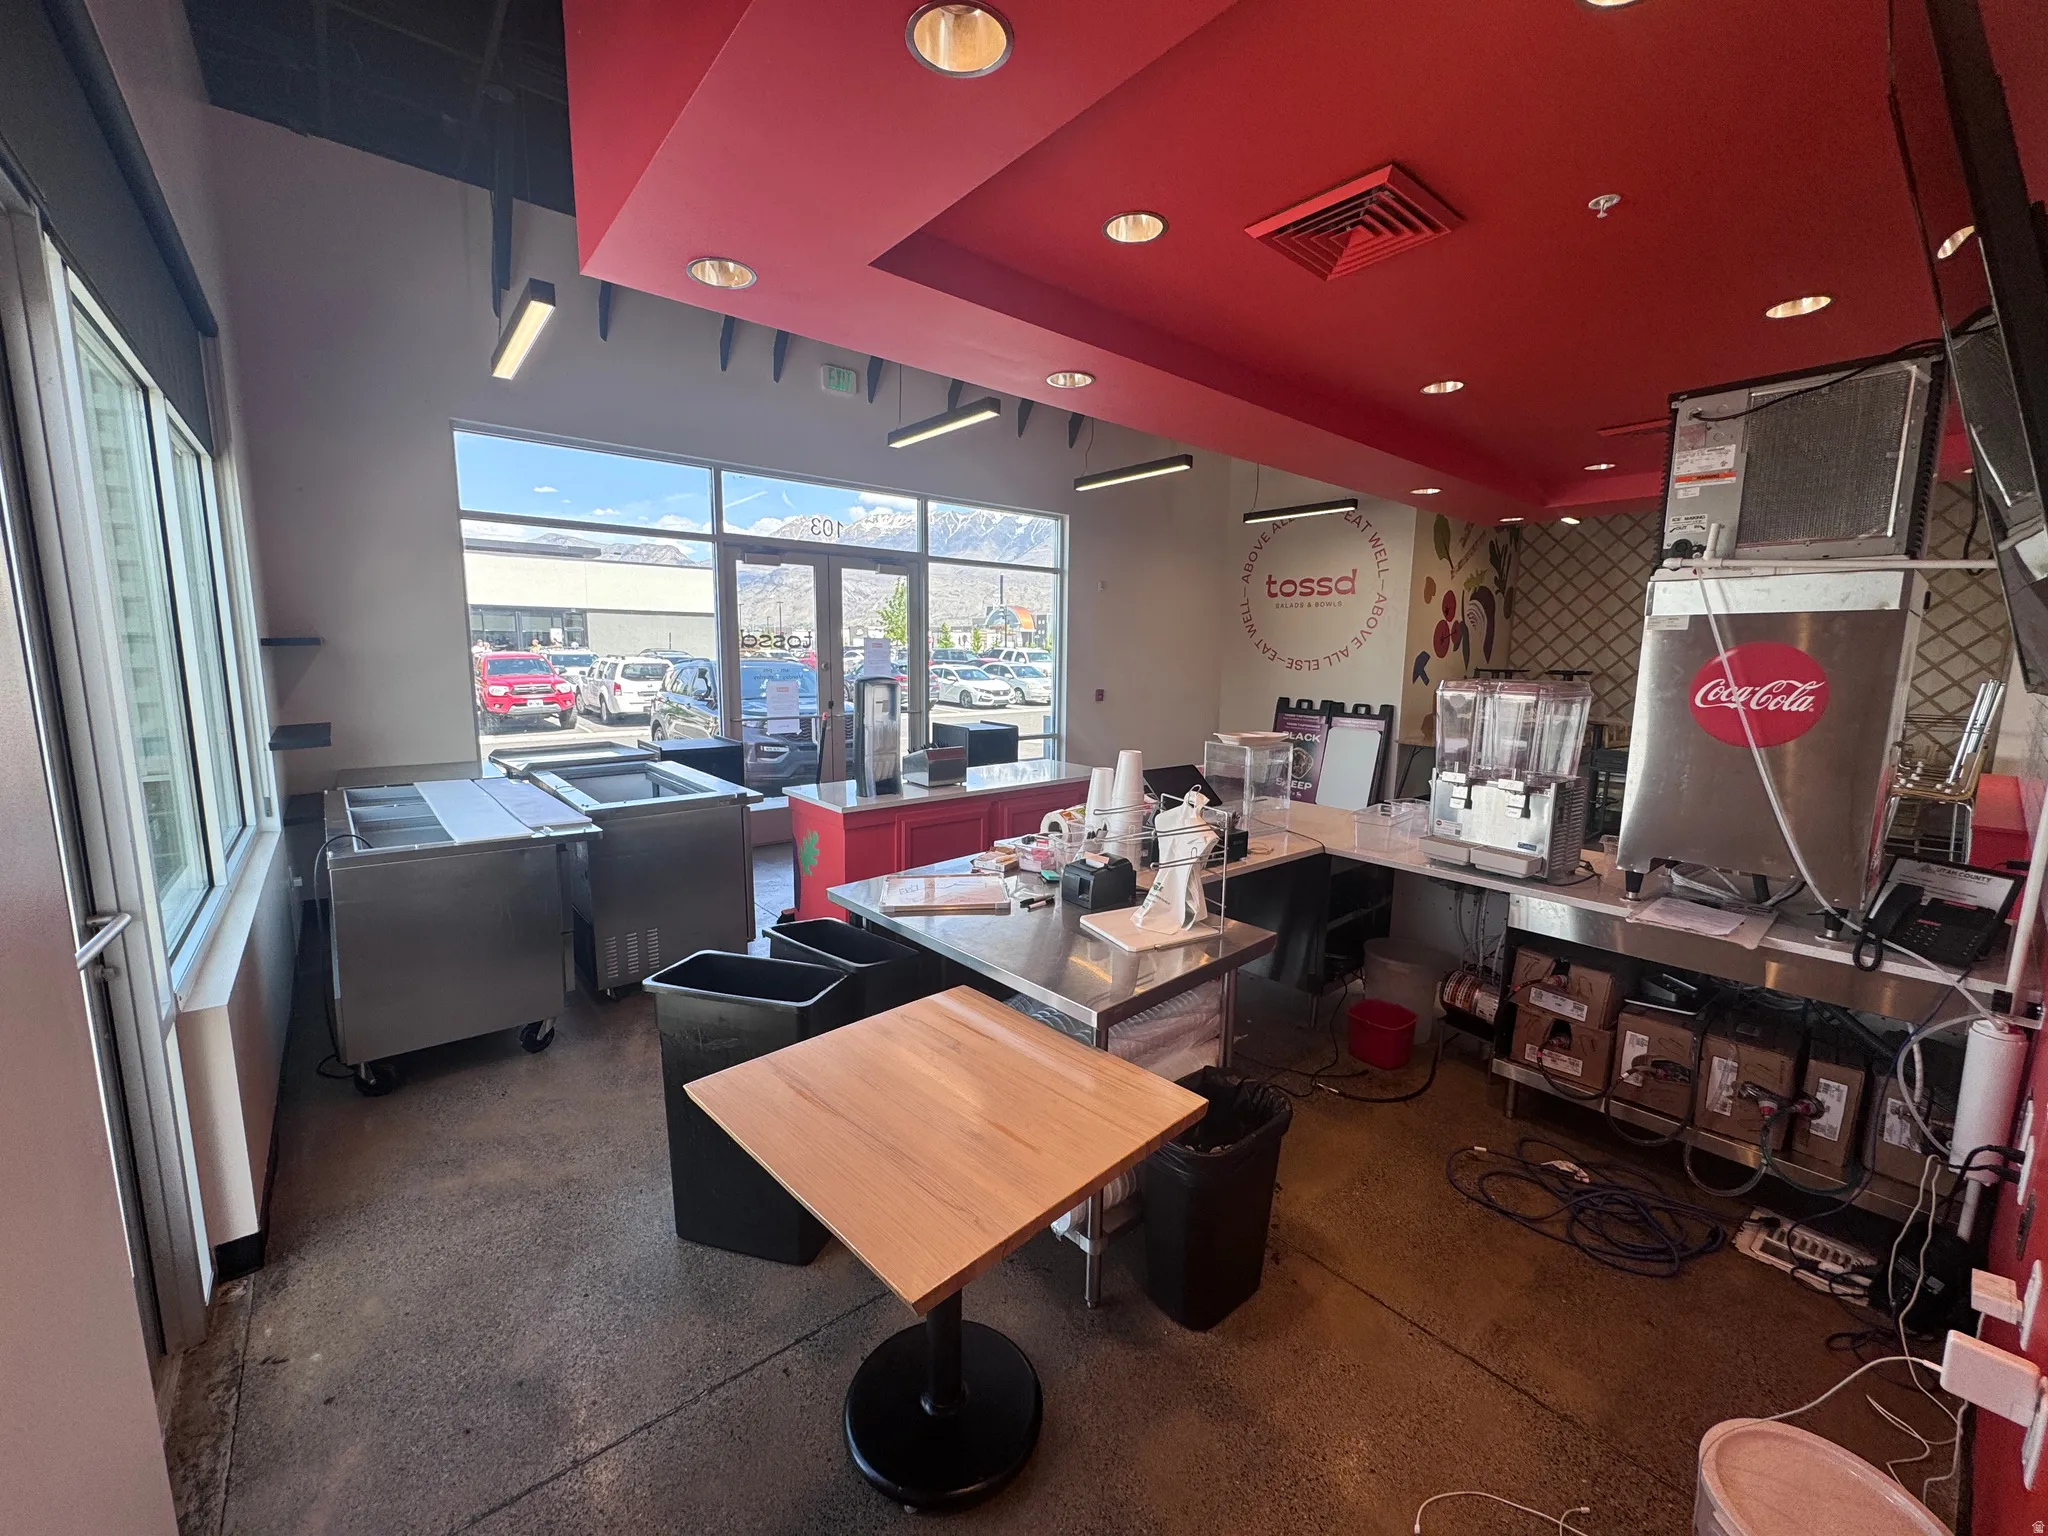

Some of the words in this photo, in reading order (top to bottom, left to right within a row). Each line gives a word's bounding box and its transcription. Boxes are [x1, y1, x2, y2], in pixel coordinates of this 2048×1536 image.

[1266, 568, 1358, 599] tossd
[1694, 678, 1825, 712] Coca-Cola
[1958, 872, 1992, 883] COUNTY
